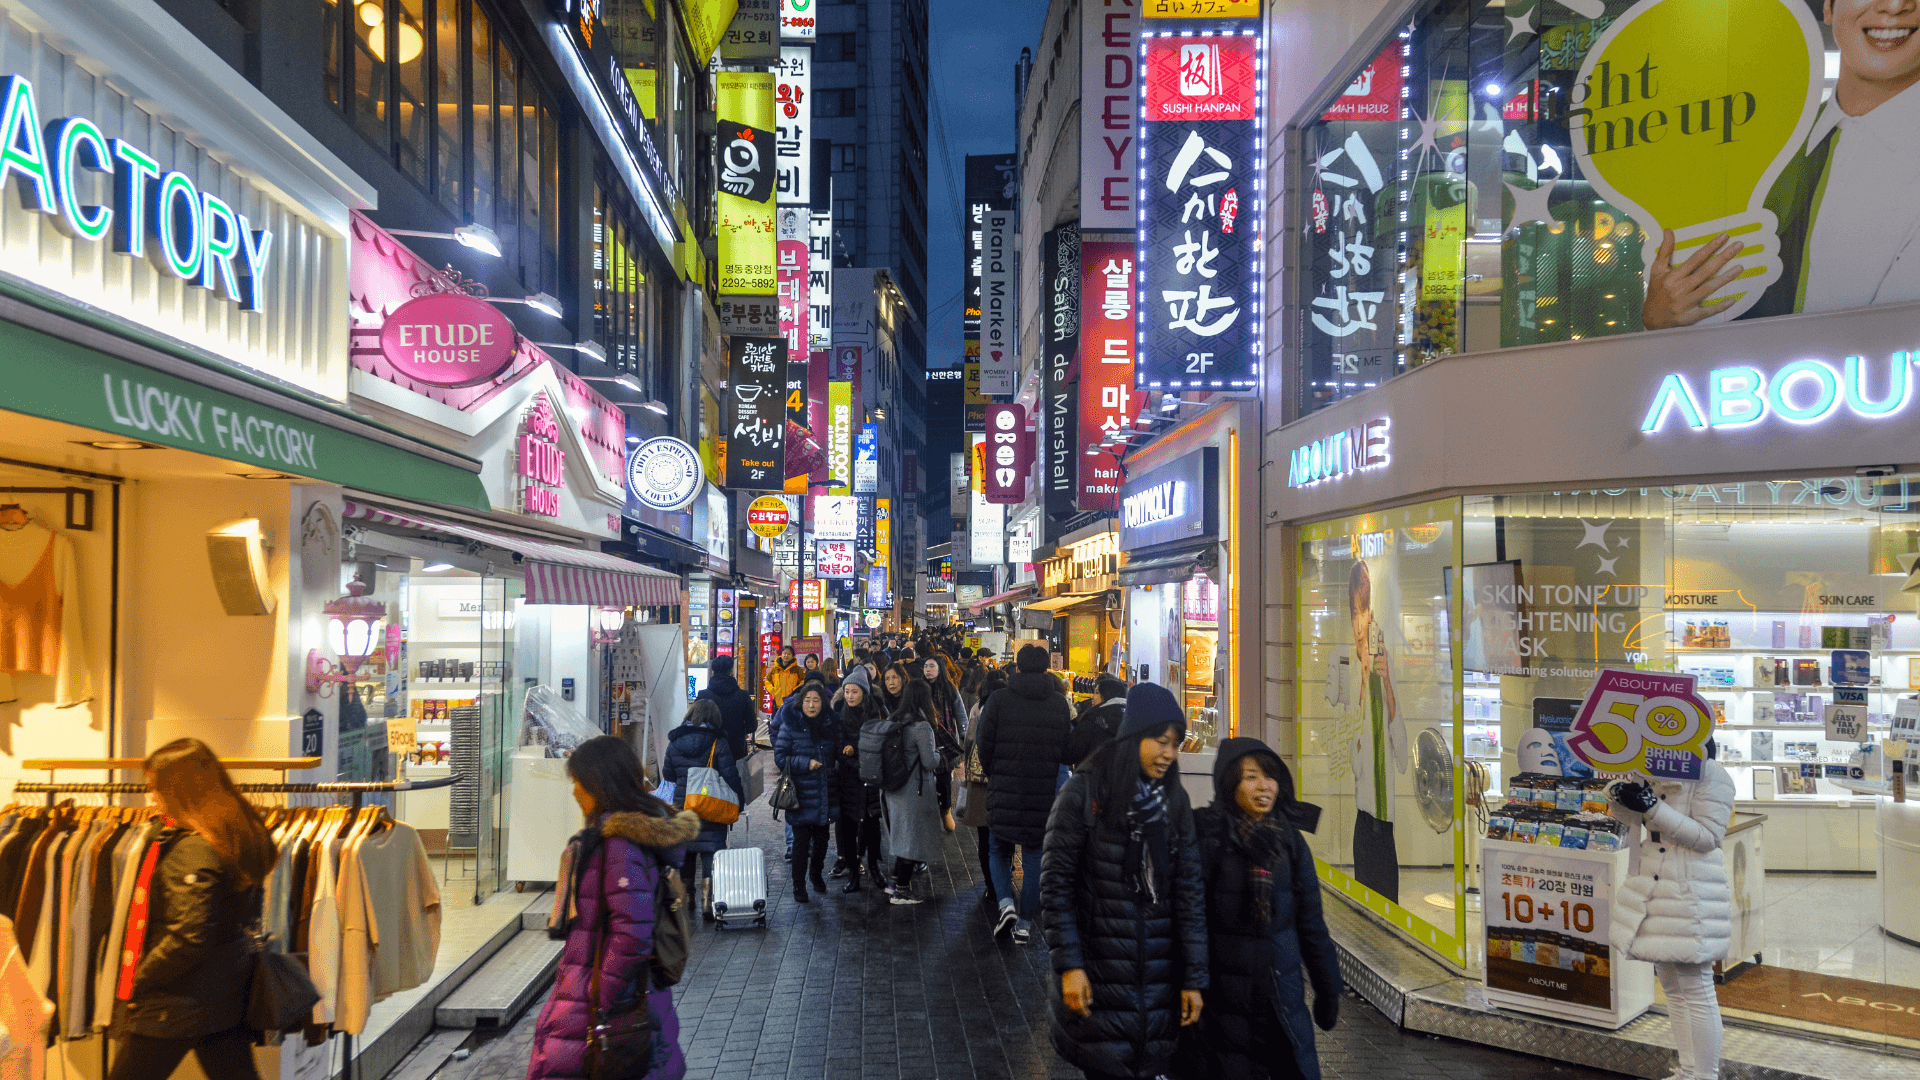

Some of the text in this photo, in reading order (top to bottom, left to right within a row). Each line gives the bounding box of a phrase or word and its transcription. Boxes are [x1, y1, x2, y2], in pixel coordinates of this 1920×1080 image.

[1101, 0, 1132, 211] EDEYE
[1162, 102, 1241, 113] SUSHI HANPAN
[1582, 90, 1757, 156] me up
[722, 278, 775, 288] 2292-5892
[990, 217, 1006, 349] Brand Market
[732, 304, 777, 325] 부동산
[399, 323, 495, 348] ETUDE
[414, 348, 481, 363] HOUSE
[1186, 352, 1214, 374] 2F
[787, 380, 802, 389] art
[1054, 276, 1069, 491] Salon de Marshall
[1641, 351, 1920, 434] ABOU
[104, 373, 318, 470] LUCKY FACTORY
[1288, 418, 1390, 488] ABOUT ME
[522, 434, 566, 489] ETUDE
[740, 458, 774, 467] Take out
[750, 469, 765, 479] 2F
[528, 486, 561, 518] HOUSE
[1482, 585, 1648, 606] SKIN TONE UP
[1664, 595, 1718, 605] MOISTURE
[1818, 595, 1875, 606] SKIN CARE
[459, 602, 486, 612] Men
[1608, 677, 1684, 693] ABOUT ME
[1838, 692, 1865, 701] VISA
[1836, 714, 1856, 722] EASY
[1836, 727, 1856, 735] FREE
[306, 734, 317, 753] 20
[1645, 747, 1692, 761] BRAND
[1645, 758, 1690, 773] SALE
[1501, 873, 1594, 897] 초특가 20장 만원
[1528, 977, 1568, 990] ABOUT ME
